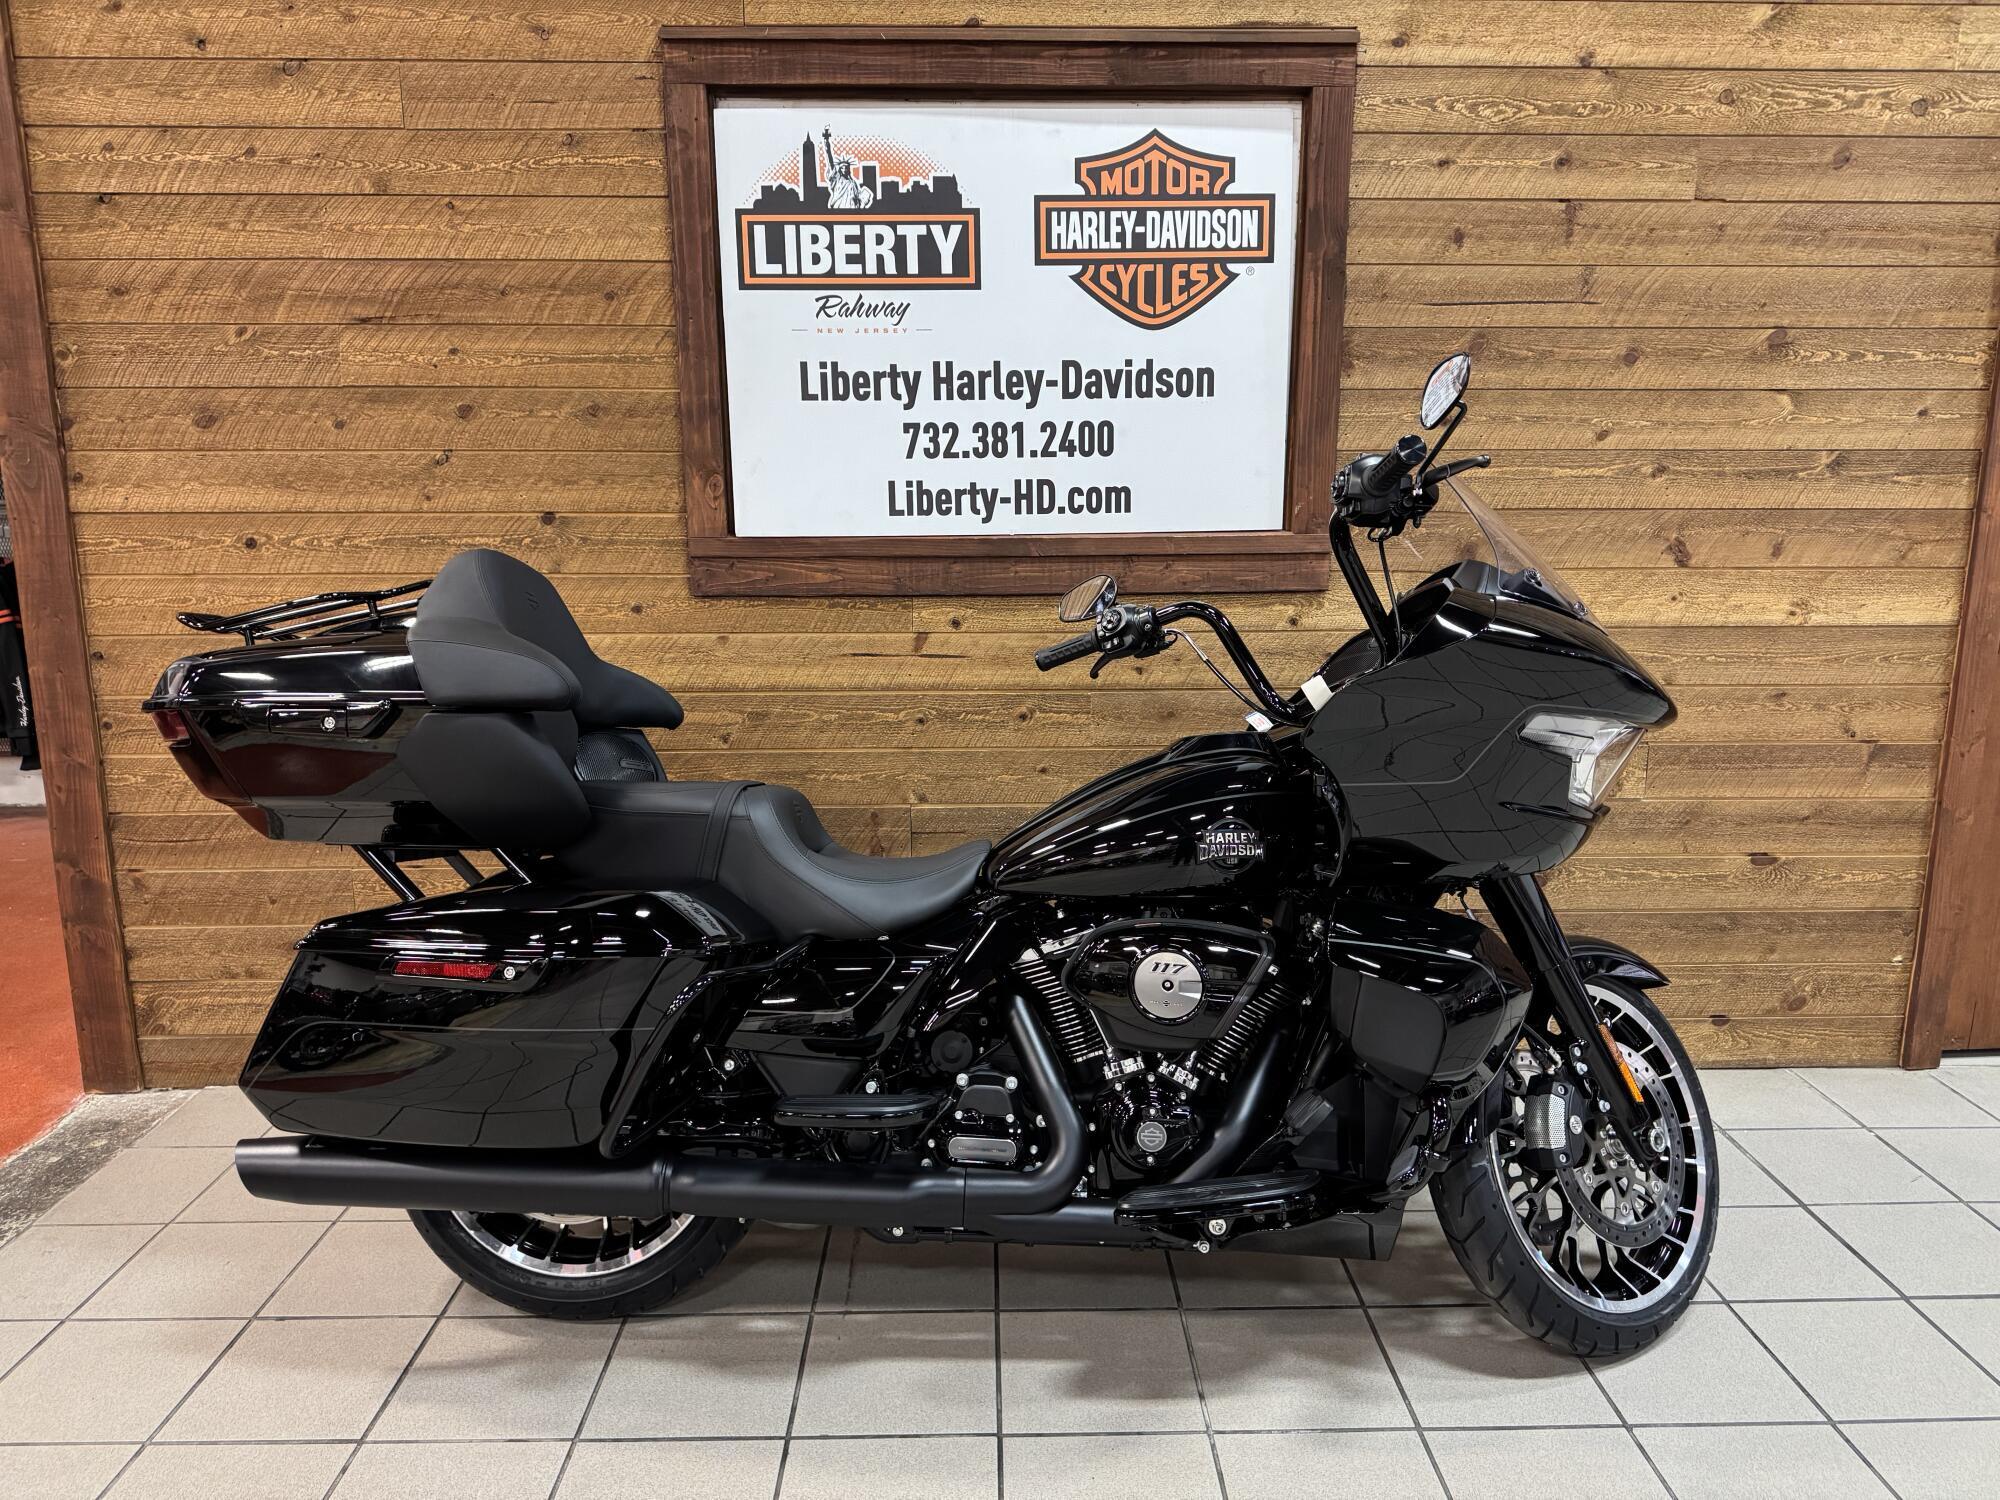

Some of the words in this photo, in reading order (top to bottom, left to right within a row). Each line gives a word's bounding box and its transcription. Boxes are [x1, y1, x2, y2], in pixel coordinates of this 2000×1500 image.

[1100, 149, 1211, 196] MOTOR
[753, 224, 963, 275] LIBERTY
[1051, 208, 1260, 250] HARLEY-DAVIDSON
[814, 293, 912, 327] Rahway
[1100, 263, 1210, 315] CYCLES
[799, 361, 922, 411] Liberty
[932, 358, 1215, 410] Harley-Davidson
[902, 419, 1115, 460] 732.381.2400
[887, 478, 1132, 524] Liberty-HD.com
[1151, 961, 1188, 974] 117
